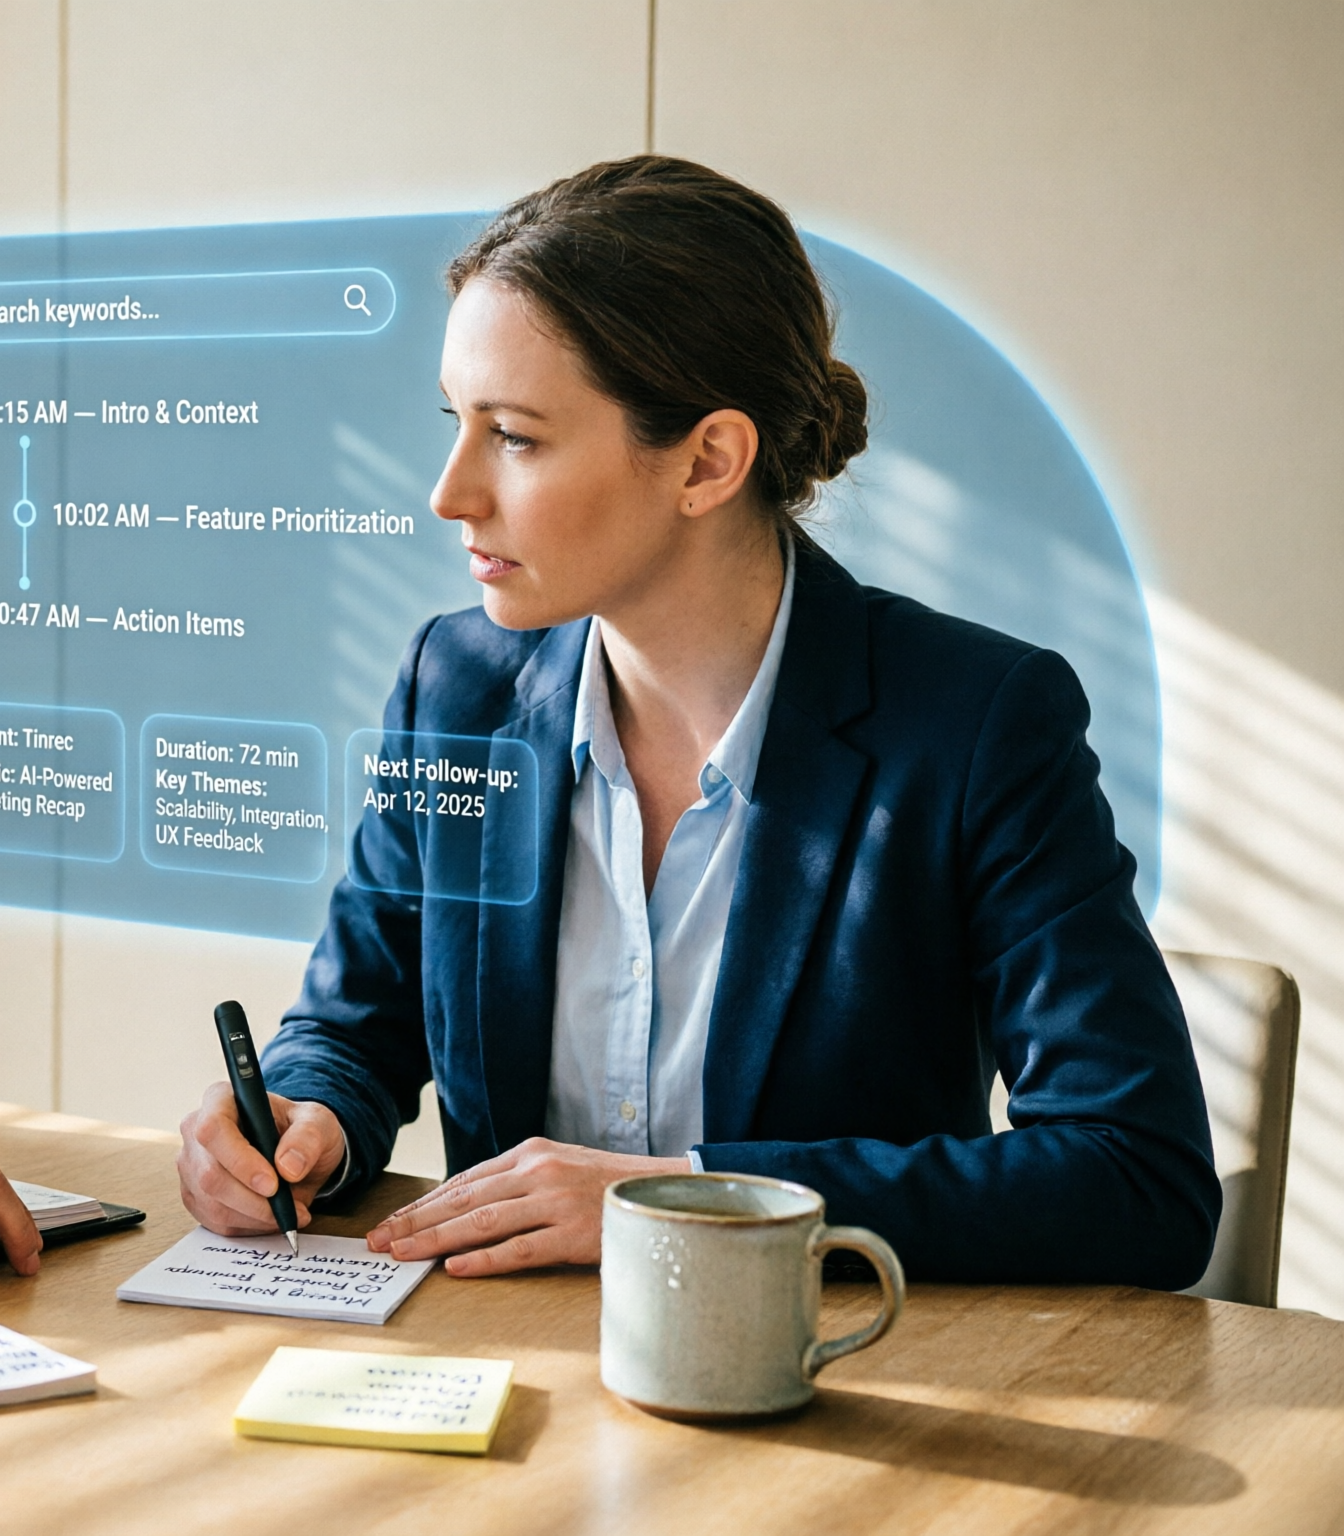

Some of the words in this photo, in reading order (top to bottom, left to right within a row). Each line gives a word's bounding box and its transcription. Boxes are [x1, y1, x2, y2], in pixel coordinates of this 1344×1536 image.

[45, 295, 159, 328] keywords...
[33, 400, 67, 424] AM
[102, 399, 149, 424] Intro
[155, 399, 170, 424] &
[176, 399, 259, 424] Context
[53, 502, 109, 527] 10:02
[114, 503, 149, 528] AM
[186, 505, 266, 531] Feature
[272, 507, 414, 535] Prioritization
[45, 604, 80, 628] AM
[113, 607, 179, 634] Action
[186, 610, 245, 637] Items
[22, 728, 74, 751] Tinrec
[156, 737, 234, 763] Duration:
[239, 743, 261, 765] 72
[266, 746, 299, 768] min
[19, 765, 113, 792] AI-Powered
[156, 769, 187, 795] Key
[191, 771, 267, 797] Themes:
[364, 754, 408, 778] Next
[414, 758, 518, 791] Follow-up:
[36, 794, 85, 822] Recap
[156, 797, 236, 827] Scalability,
[241, 805, 329, 834] Integration,
[363, 787, 397, 814] Apr
[403, 790, 430, 816] 12,
[437, 793, 485, 817] 2025
[156, 824, 179, 845] UX
[184, 826, 264, 853] Feedback
